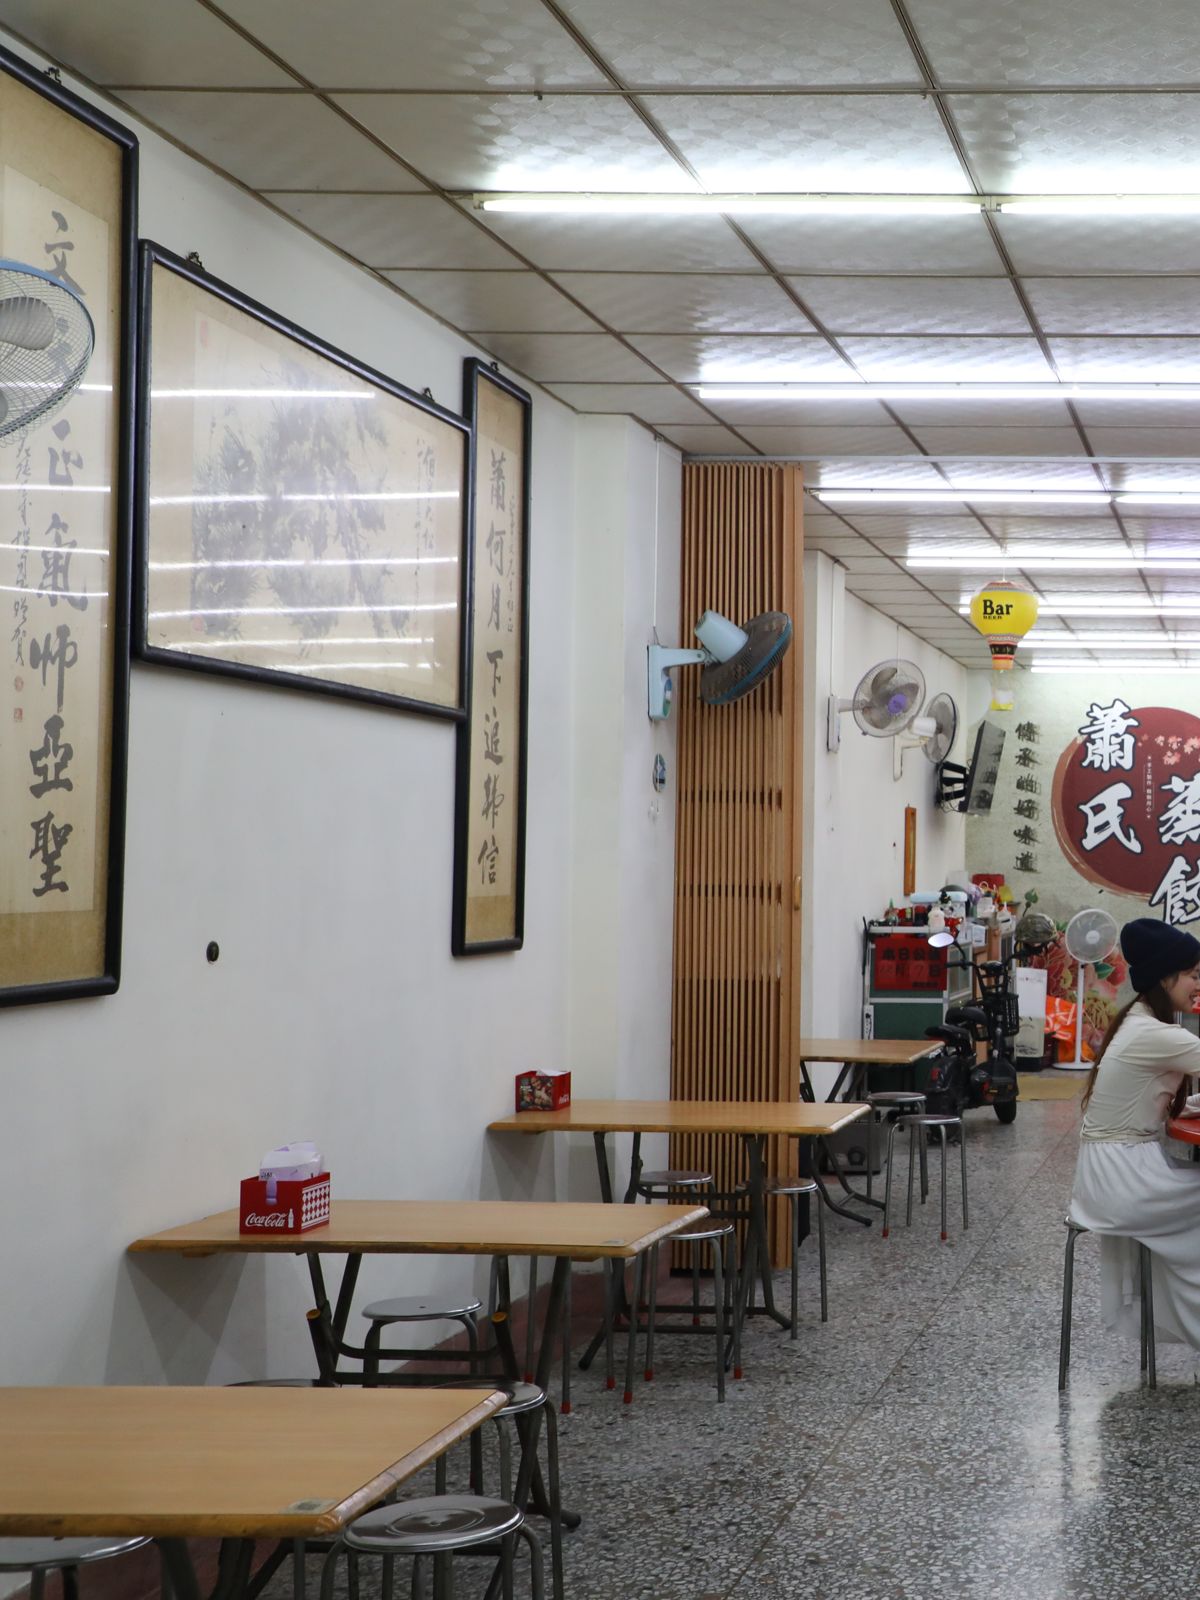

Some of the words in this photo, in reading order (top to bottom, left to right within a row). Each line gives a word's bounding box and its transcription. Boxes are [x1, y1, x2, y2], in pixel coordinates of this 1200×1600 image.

[983, 599, 1013, 615] Bar
[1079, 699, 1142, 854] 蕭氏
[245, 1212, 287, 1227] Coca-Cola
